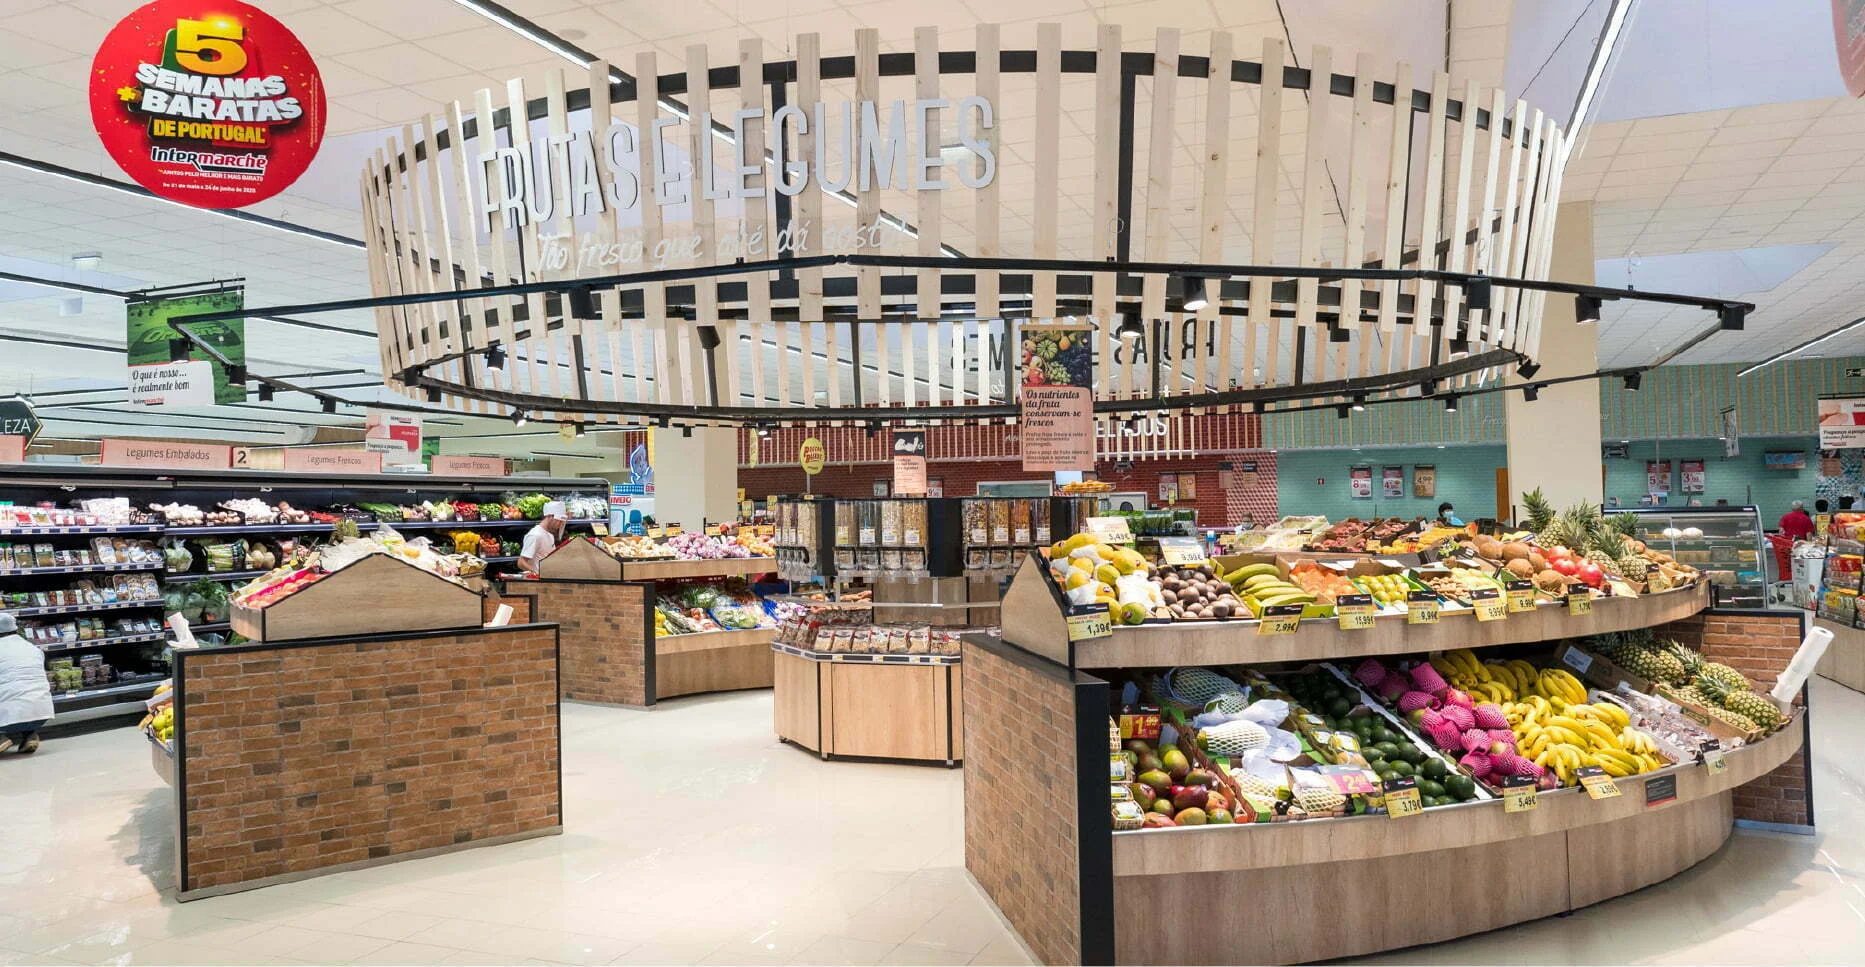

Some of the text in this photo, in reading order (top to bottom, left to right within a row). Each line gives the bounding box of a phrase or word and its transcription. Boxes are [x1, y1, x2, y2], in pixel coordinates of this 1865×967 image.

[175, 18, 248, 75] 5
[135, 63, 287, 99] SEMANAS
[141, 88, 304, 122] BARATAS
[153, 119, 176, 137] DE
[477, 96, 996, 233] FRUTAS E LEGUMES
[574, 231, 644, 278] fresco
[654, 234, 704, 271] que
[776, 218, 812, 253] dá
[132, 370, 139, 379] O
[139, 371, 152, 383] que
[153, 368, 158, 378] é
[132, 381, 190, 393] é realmente bom
[1025, 389, 1080, 399] Os nutrientes
[1025, 418, 1054, 428] frescos
[126, 447, 210, 461] Legumes Embalados
[307, 455, 336, 465] Legumes
